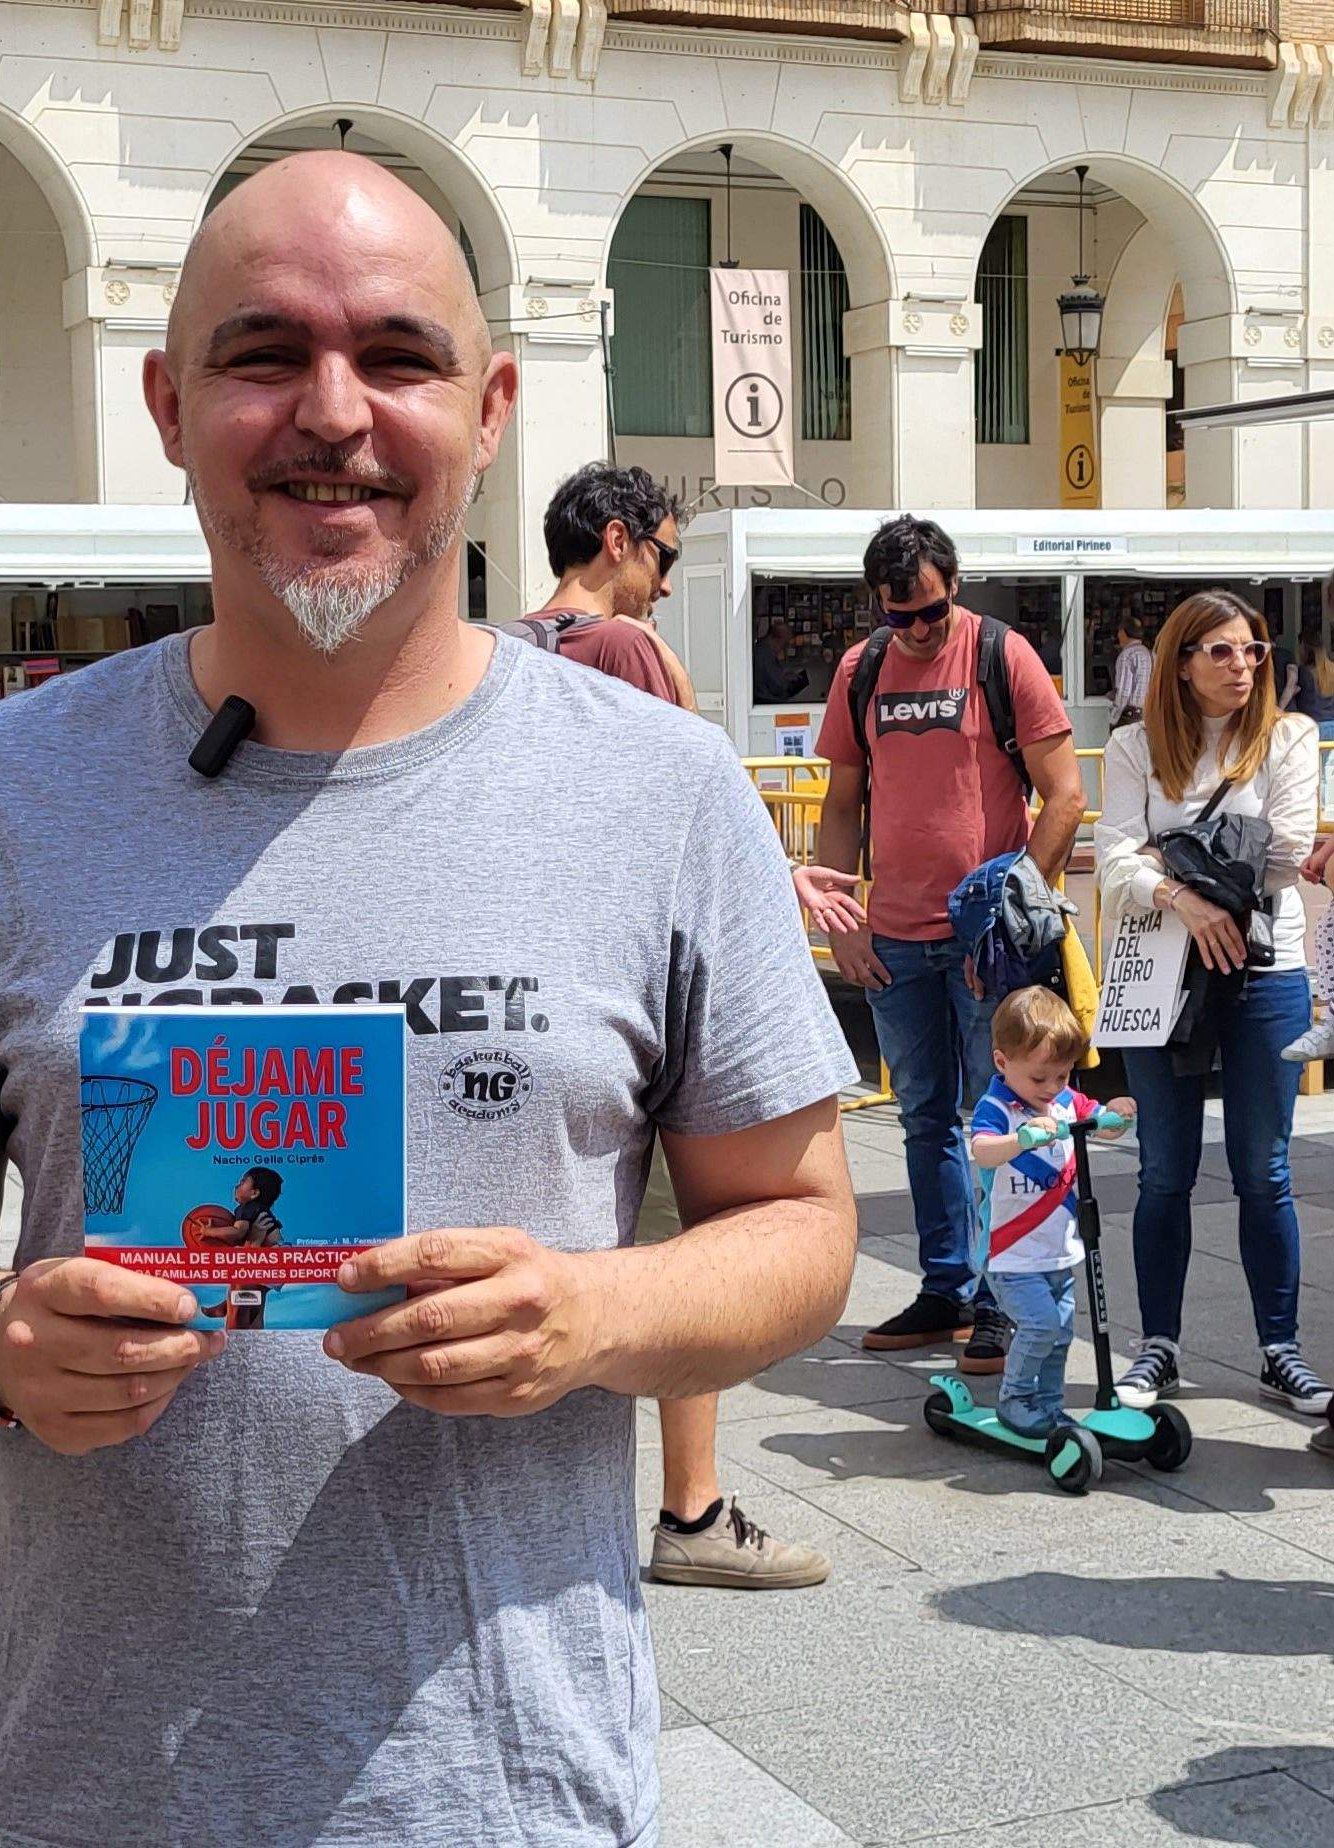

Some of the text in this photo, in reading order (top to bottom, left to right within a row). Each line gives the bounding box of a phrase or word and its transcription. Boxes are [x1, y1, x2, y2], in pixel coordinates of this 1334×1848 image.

[728, 290, 782, 306] Oficina
[763, 310, 782, 326] de
[720, 329, 783, 345] Turismo
[1033, 539, 1112, 552] Editorial Pirineo
[1119, 909, 1163, 934] FERIA
[90, 922, 296, 990] JUST
[1114, 935, 1141, 959] DEL
[1110, 958, 1154, 983] LIBRO
[1105, 984, 1126, 1008] DE
[1099, 1007, 1161, 1033] HUESCA
[170, 1033, 365, 1098] DÉJAME
[184, 1099, 349, 1151] JUGAR
[212, 1154, 251, 1165] Nacho
[120, 1252, 186, 1265] MANUAL
[189, 1252, 211, 1265] DE
[214, 1251, 279, 1265] BUENAS
[154, 1269, 209, 1279] FAMILIAS
[212, 1269, 229, 1279] DE
[231, 1267, 287, 1279] JÓVENES
